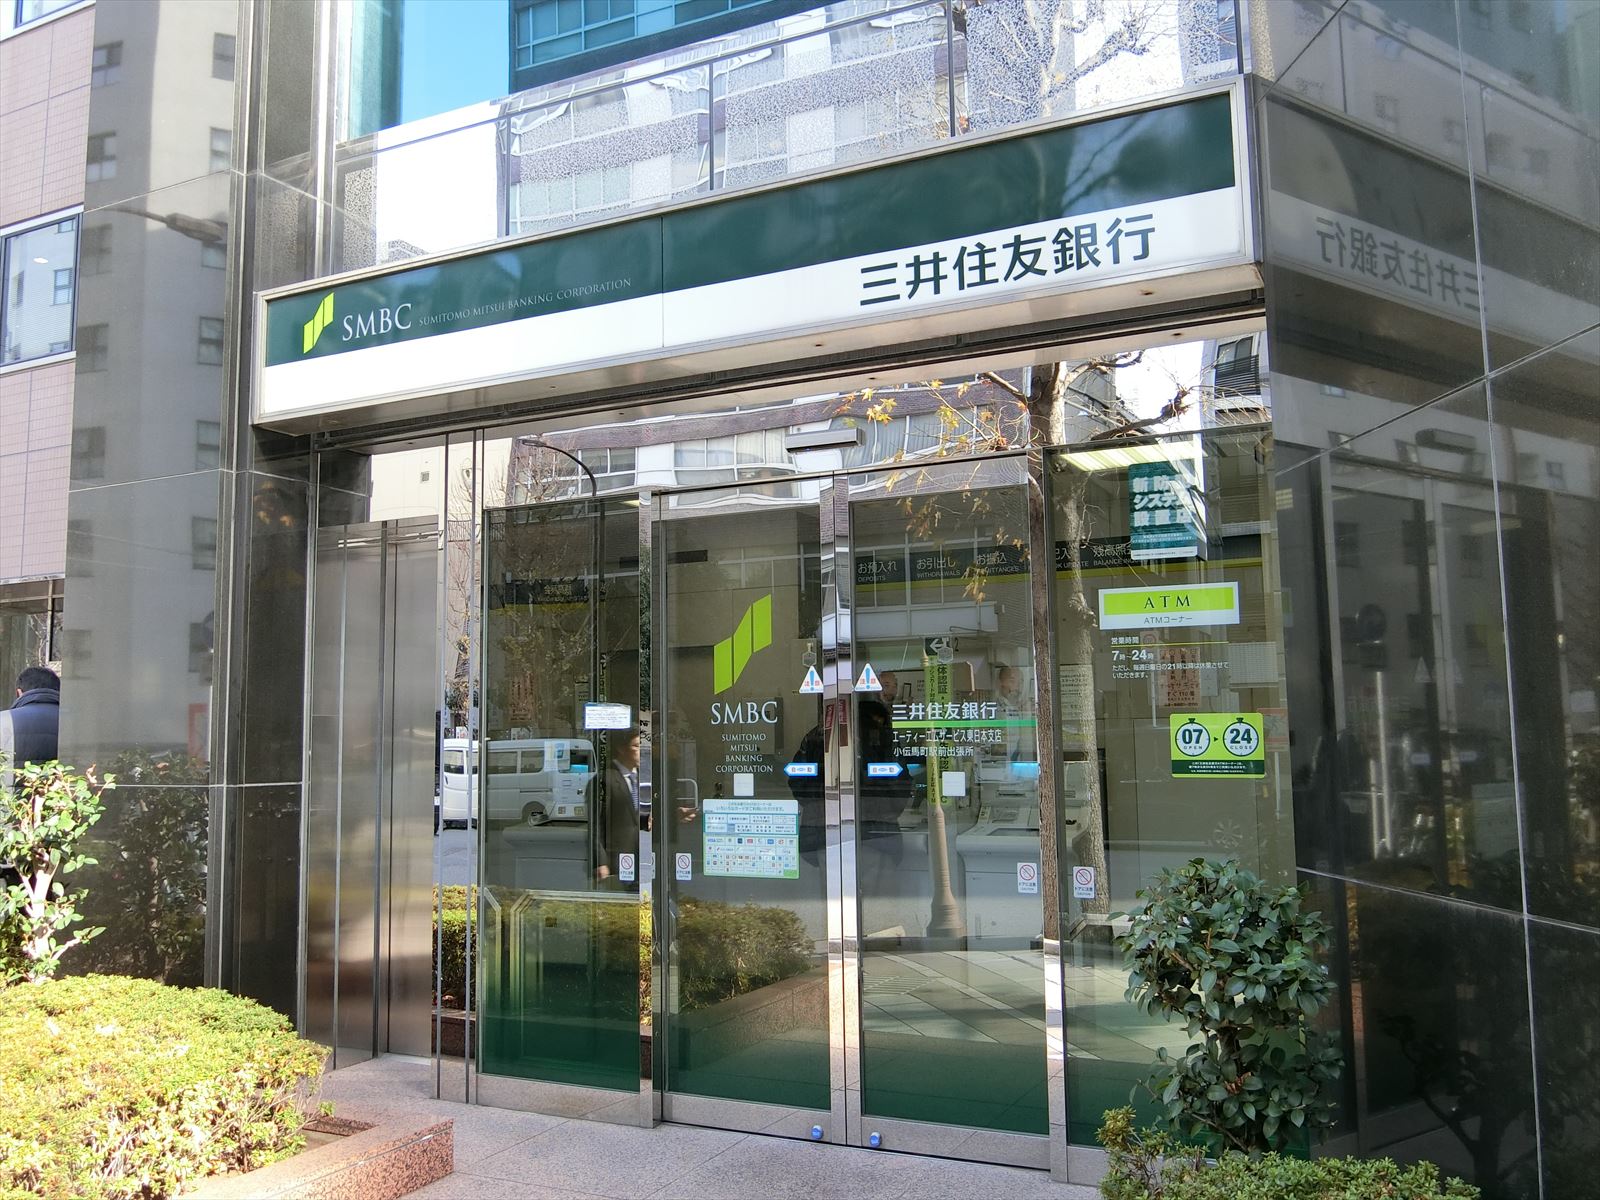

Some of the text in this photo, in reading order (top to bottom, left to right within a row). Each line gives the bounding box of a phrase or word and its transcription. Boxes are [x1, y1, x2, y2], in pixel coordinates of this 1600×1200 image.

[860, 213, 1156, 306] 三井住友銀行
[342, 278, 631, 341] SMBC SUMITOMO MITSUI BANKING CORPORATION
[916, 555, 956, 571] お引出し
[858, 574, 886, 583] DEPOSITS
[917, 569, 961, 579] WITHDRAWALS
[1144, 595, 1190, 609] ATM
[1144, 616, 1193, 624] ATMコーナー
[1111, 636, 1140, 645] 営業時間
[711, 701, 778, 725] SMBC
[892, 701, 997, 720] 三井住友銀行
[721, 733, 766, 741] SUMITOMO
[1182, 728, 1203, 744] 07
[1230, 728, 1252, 744] 24
[730, 744, 758, 752] MITSUI
[725, 754, 763, 762] BANKING
[715, 765, 773, 773] CORPORATION
